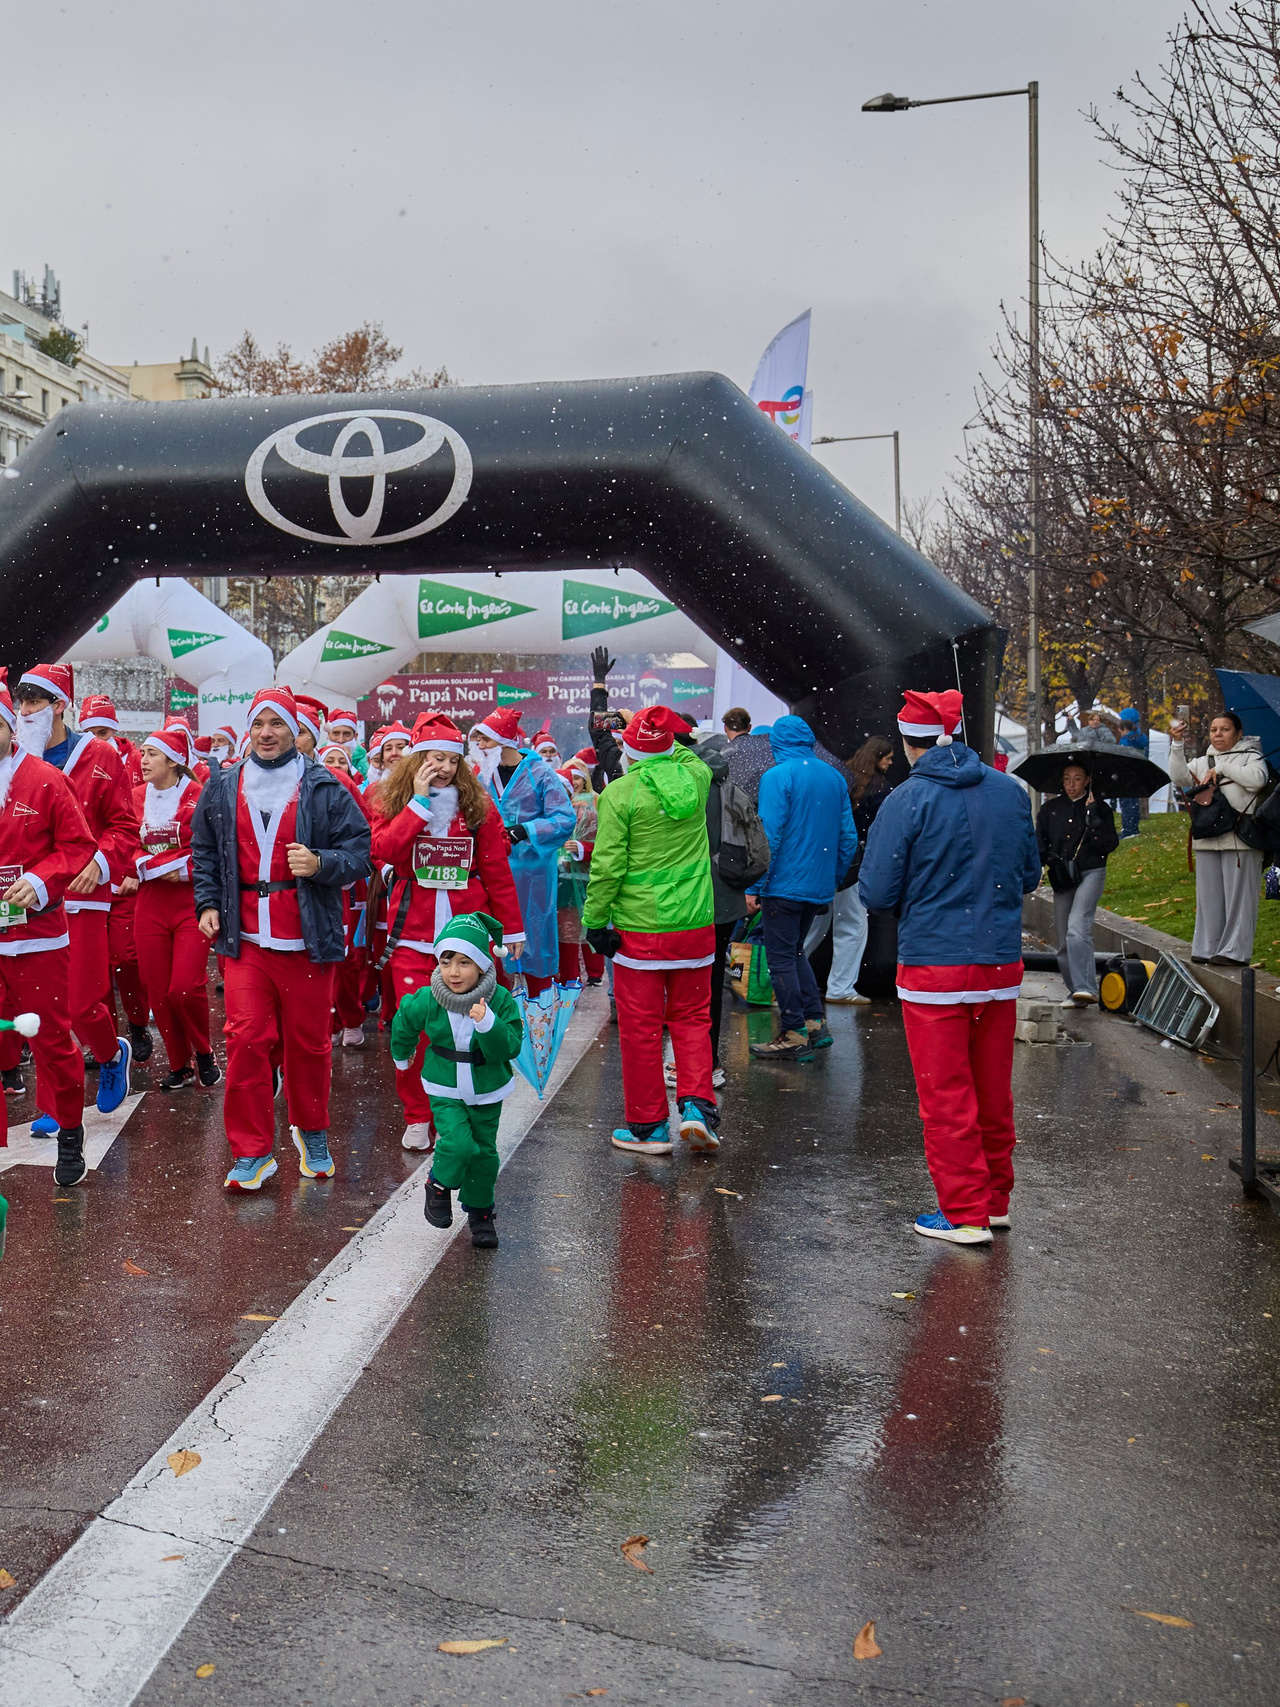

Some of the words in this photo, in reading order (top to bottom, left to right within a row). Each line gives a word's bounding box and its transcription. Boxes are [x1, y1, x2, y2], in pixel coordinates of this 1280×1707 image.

[419, 599, 434, 614] El
[436, 599, 465, 615] Corte
[466, 596, 512, 620] Inglés
[564, 599, 579, 615] El
[581, 599, 612, 615] Corte
[613, 595, 660, 619] Inglés
[325, 640, 333, 649] El
[334, 640, 352, 650] Corte
[420, 678, 450, 686] CARRERA
[228, 688, 256, 705] Inglé
[409, 687, 451, 706] Papá
[455, 686, 494, 701] Noel
[547, 684, 591, 703] Papá
[605, 683, 636, 698] oel
[0, 875, 16, 883] Noel
[426, 866, 458, 880] 7183
